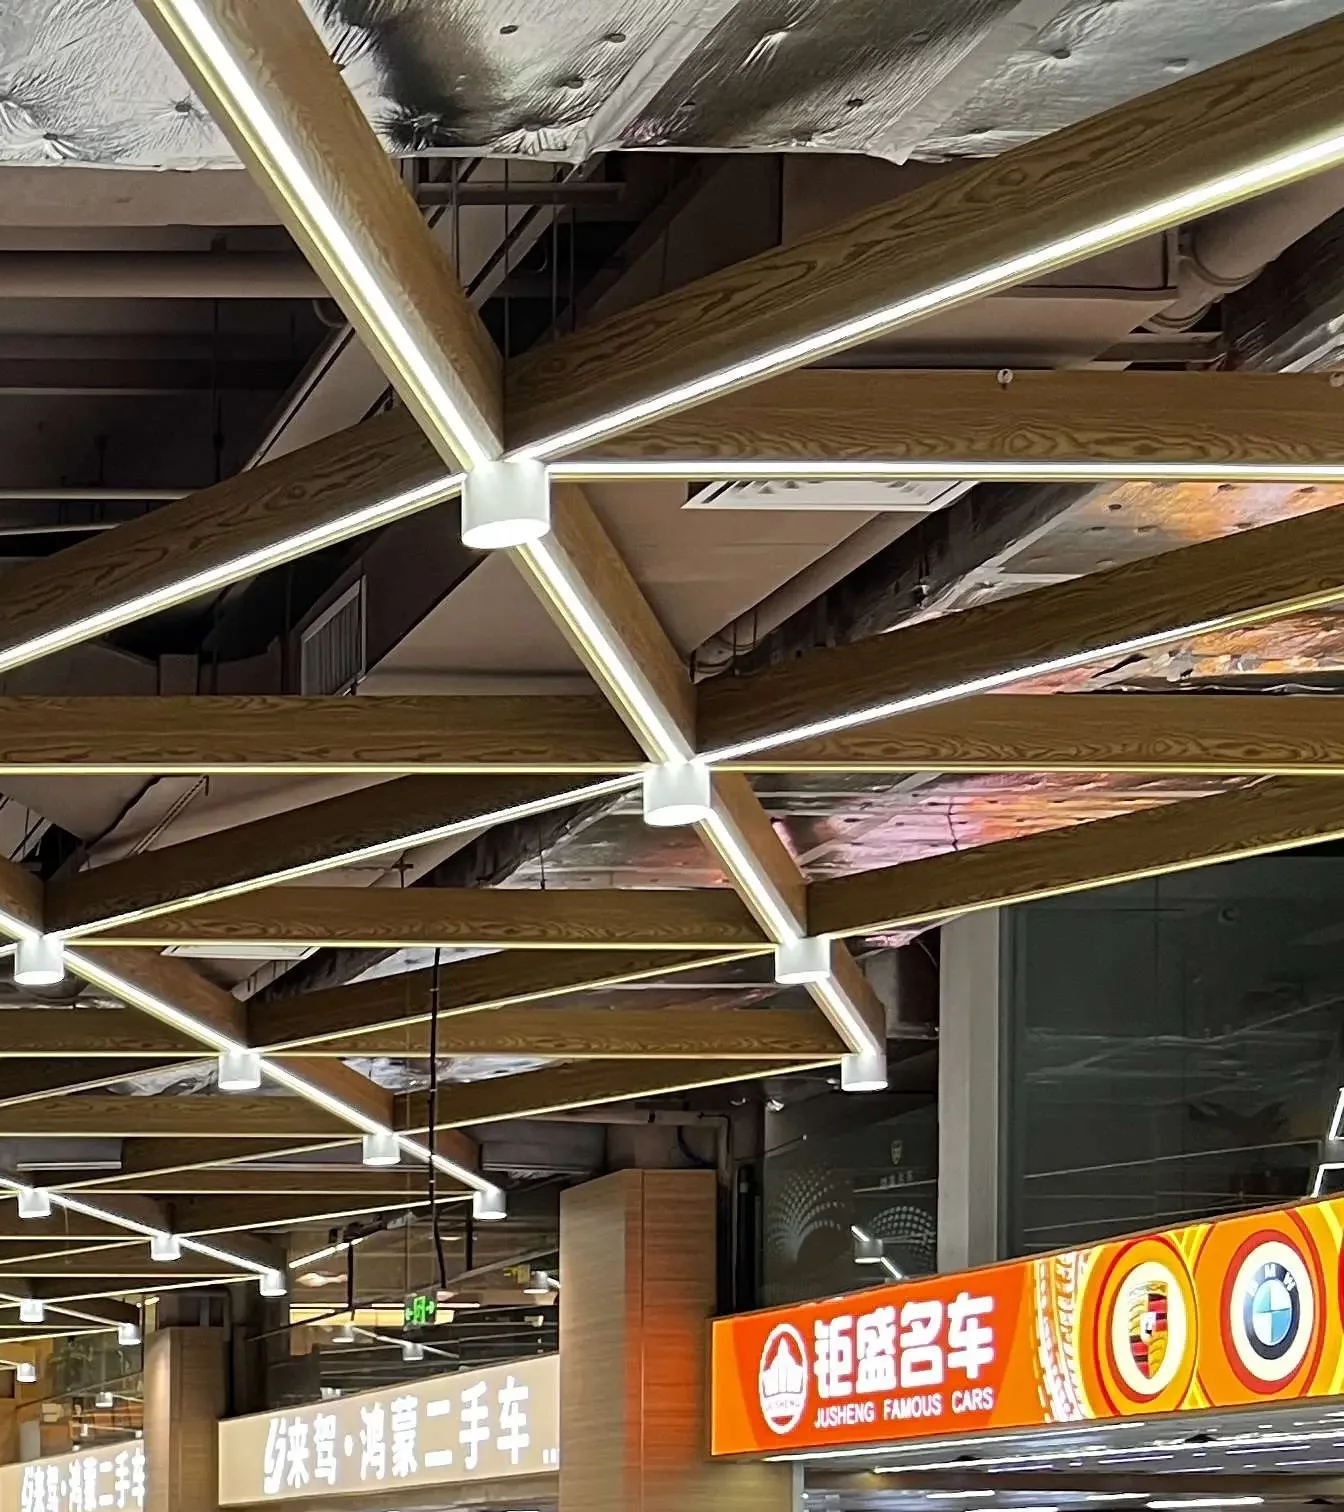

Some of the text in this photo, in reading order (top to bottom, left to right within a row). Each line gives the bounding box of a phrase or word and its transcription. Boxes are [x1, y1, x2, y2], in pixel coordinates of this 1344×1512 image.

[814, 1387, 994, 1429] JUSHENG FAMOUS CARS
